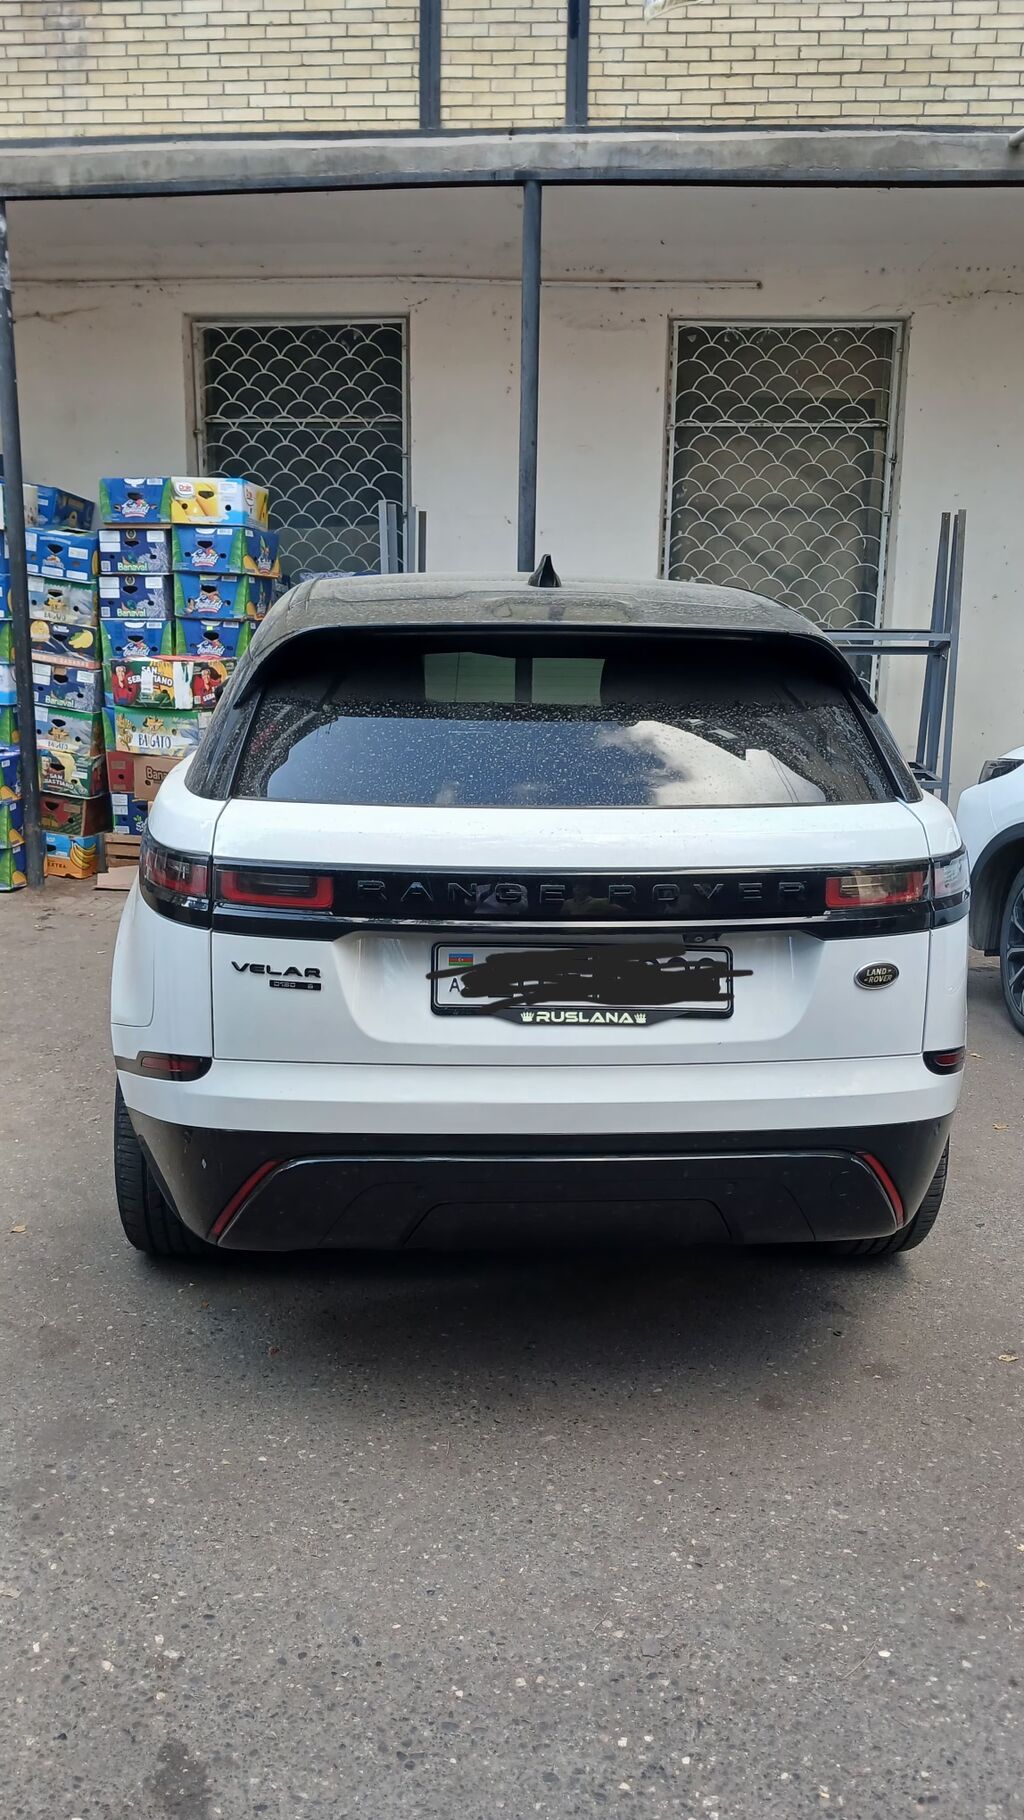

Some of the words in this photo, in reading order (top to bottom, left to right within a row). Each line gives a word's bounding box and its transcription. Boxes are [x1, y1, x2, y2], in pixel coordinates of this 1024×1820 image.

[356, 879, 571, 905] RANGE
[608, 881, 808, 905] ROVER
[231, 961, 321, 979] VELAR
[866, 967, 888, 977] LAND
[868, 974, 893, 983] ROVER
[535, 1011, 635, 1024] RUSLANA
